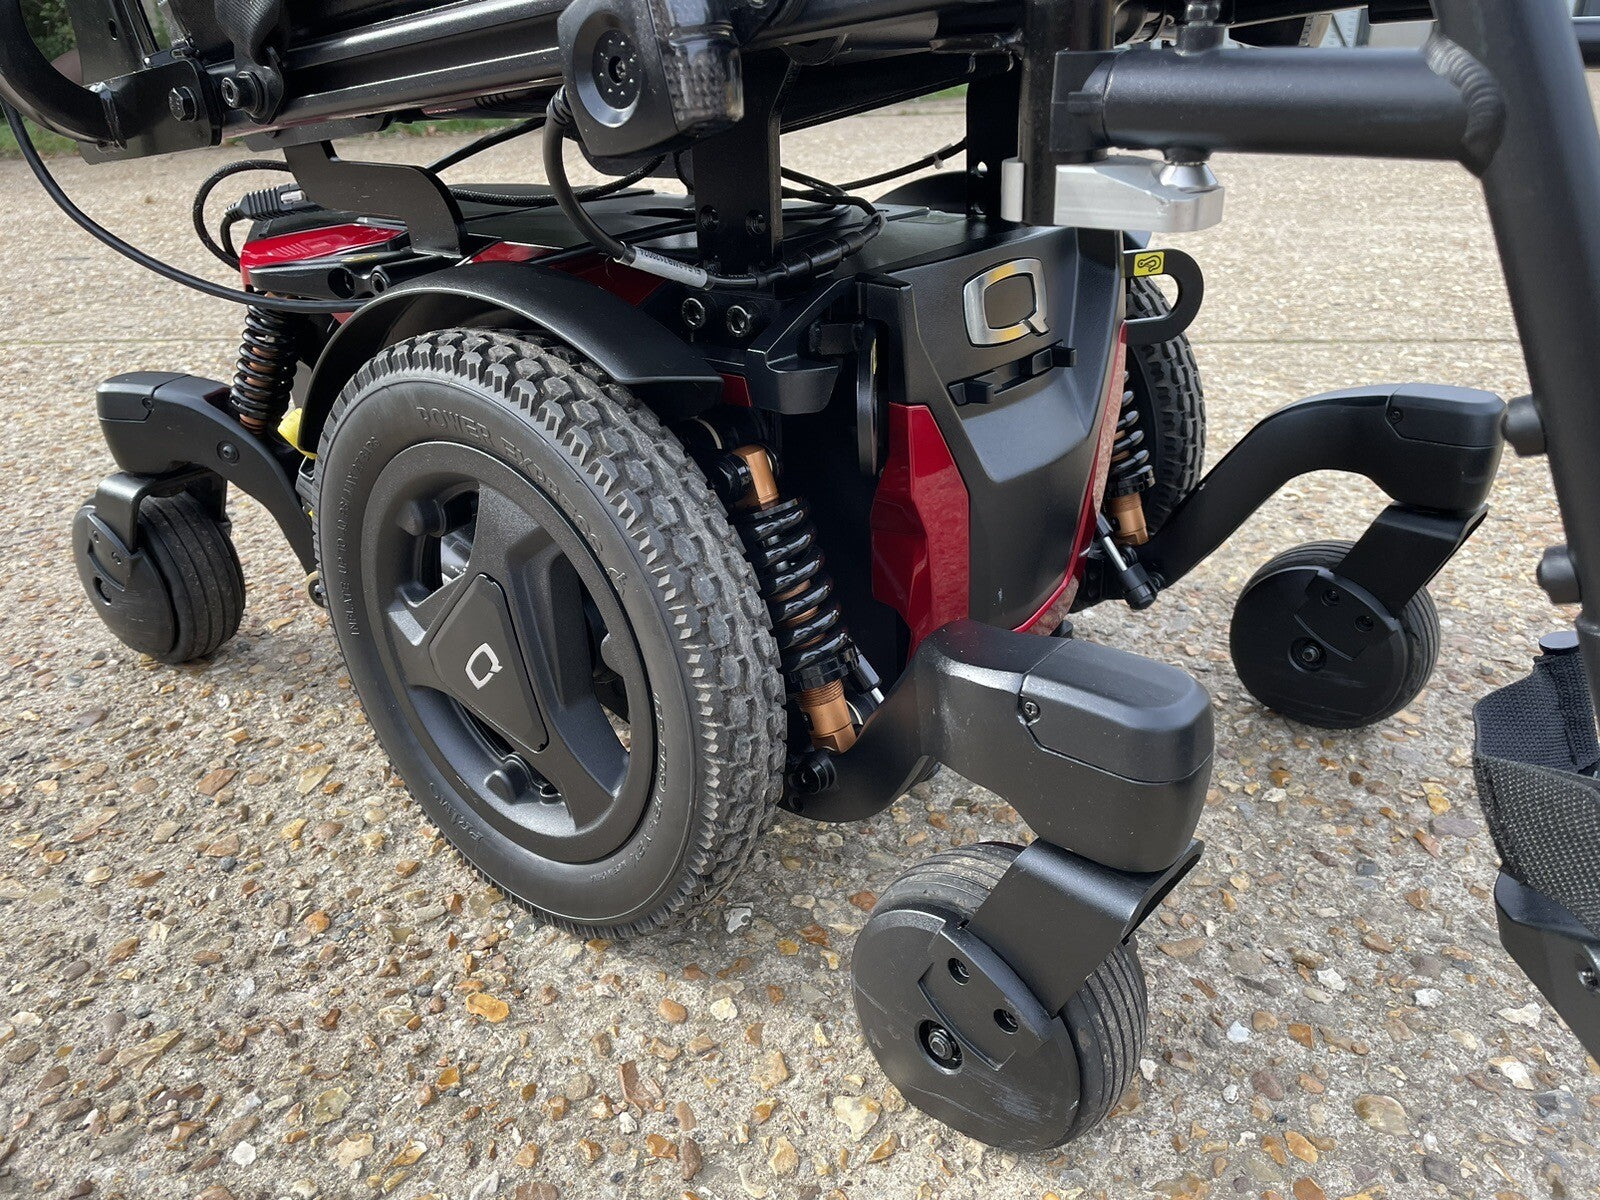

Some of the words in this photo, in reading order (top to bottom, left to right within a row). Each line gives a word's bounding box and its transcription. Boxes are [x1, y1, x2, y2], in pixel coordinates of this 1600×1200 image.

[963, 257, 1050, 348] Q
[416, 405, 491, 446] POWER
[503, 437, 603, 553] EXPRESS
[336, 557, 348, 575] UP
[340, 578, 360, 636] INFLATE
[463, 642, 504, 691] Q
